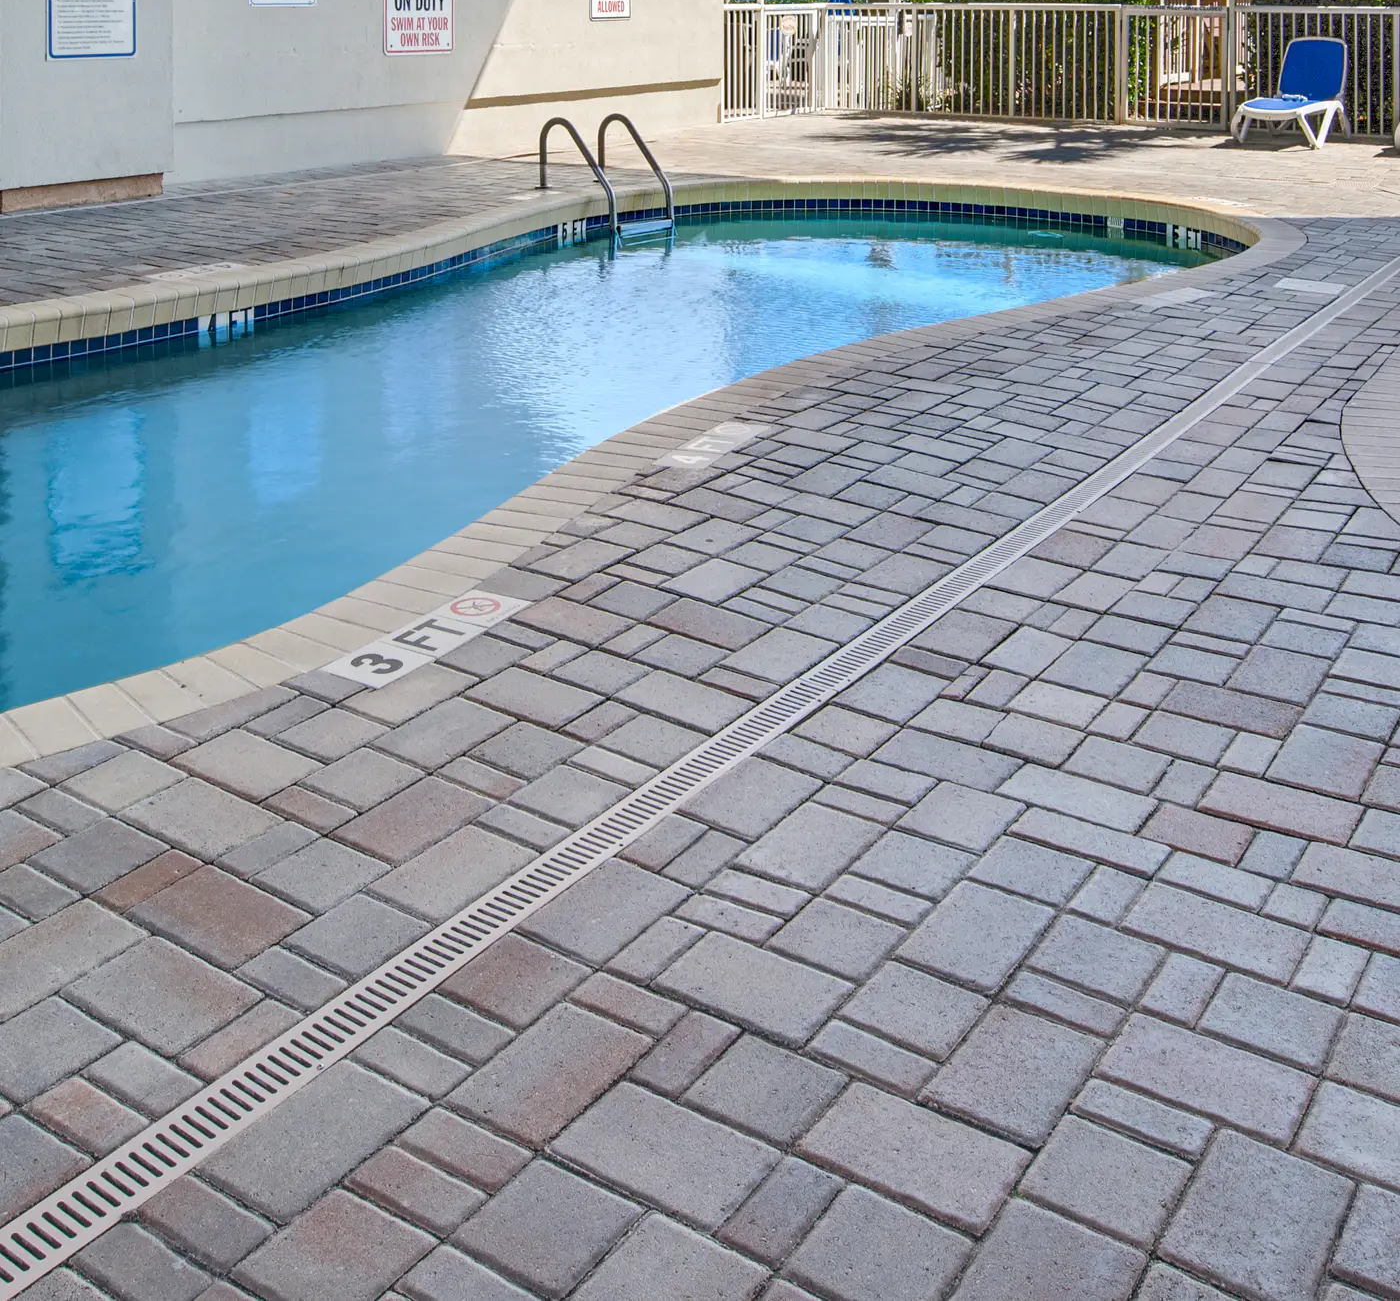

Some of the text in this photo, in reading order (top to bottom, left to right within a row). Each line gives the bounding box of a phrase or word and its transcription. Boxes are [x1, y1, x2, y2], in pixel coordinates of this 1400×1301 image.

[597, 0, 625, 13] ALLOWED
[391, 17, 449, 31] SWIM AT YOUR
[400, 32, 440, 46] OWN RISK
[687, 436, 735, 452] FT
[350, 618, 466, 675] 3 FT
